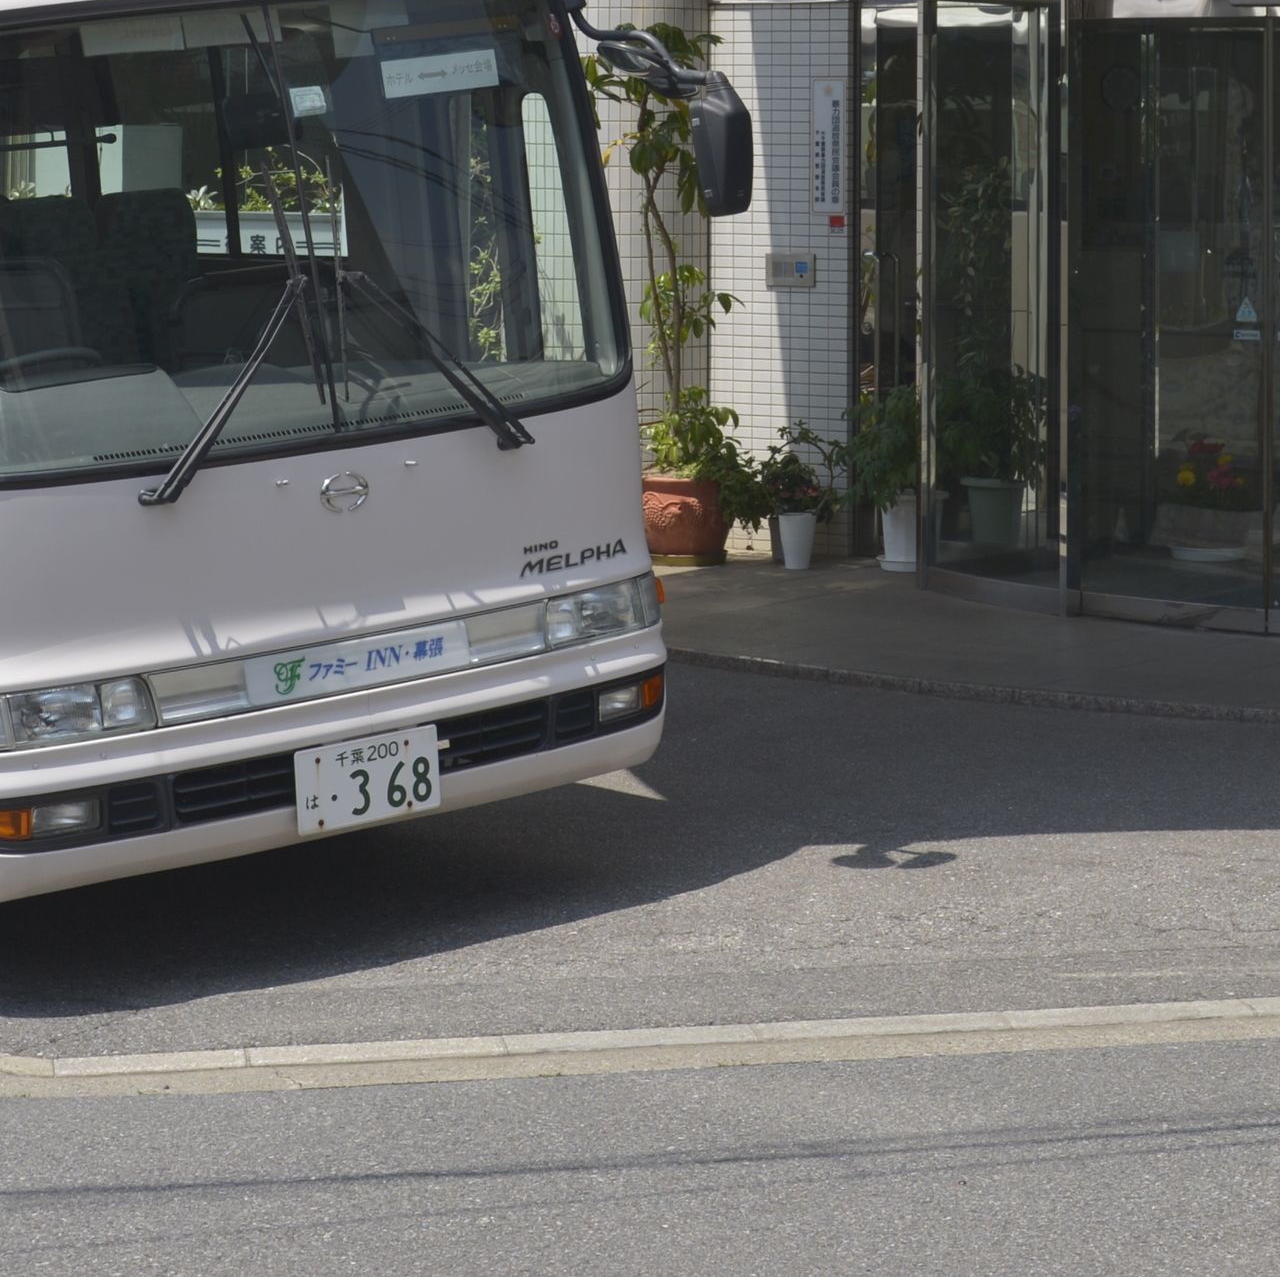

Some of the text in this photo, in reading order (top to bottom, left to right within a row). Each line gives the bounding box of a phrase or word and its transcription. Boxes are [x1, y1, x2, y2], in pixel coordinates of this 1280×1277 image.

[520, 539, 628, 577] MELPHA
[523, 539, 559, 555] HINO
[335, 740, 400, 767] 千葉200
